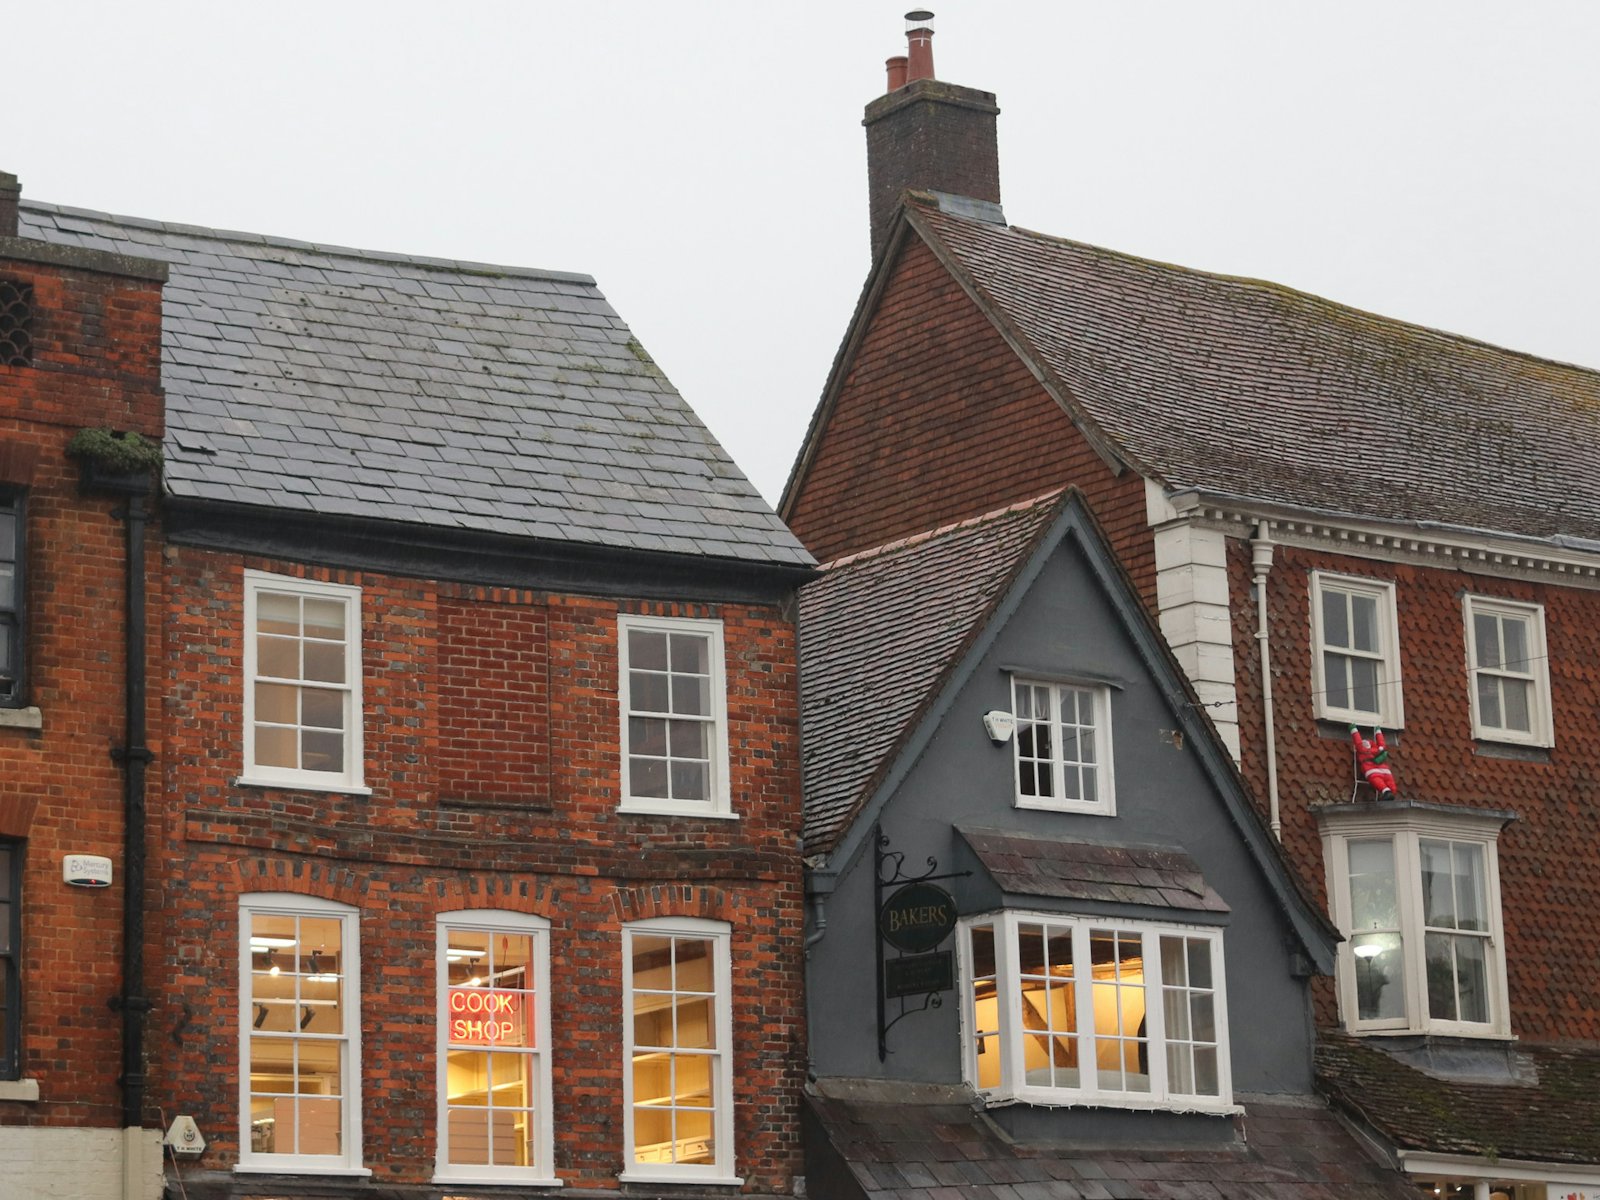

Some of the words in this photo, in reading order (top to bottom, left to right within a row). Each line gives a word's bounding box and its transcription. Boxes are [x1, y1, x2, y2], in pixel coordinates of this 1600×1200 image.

[889, 904, 948, 932] BAKERS
[451, 992, 514, 1014] COOK
[454, 1020, 514, 1040] SHOP
